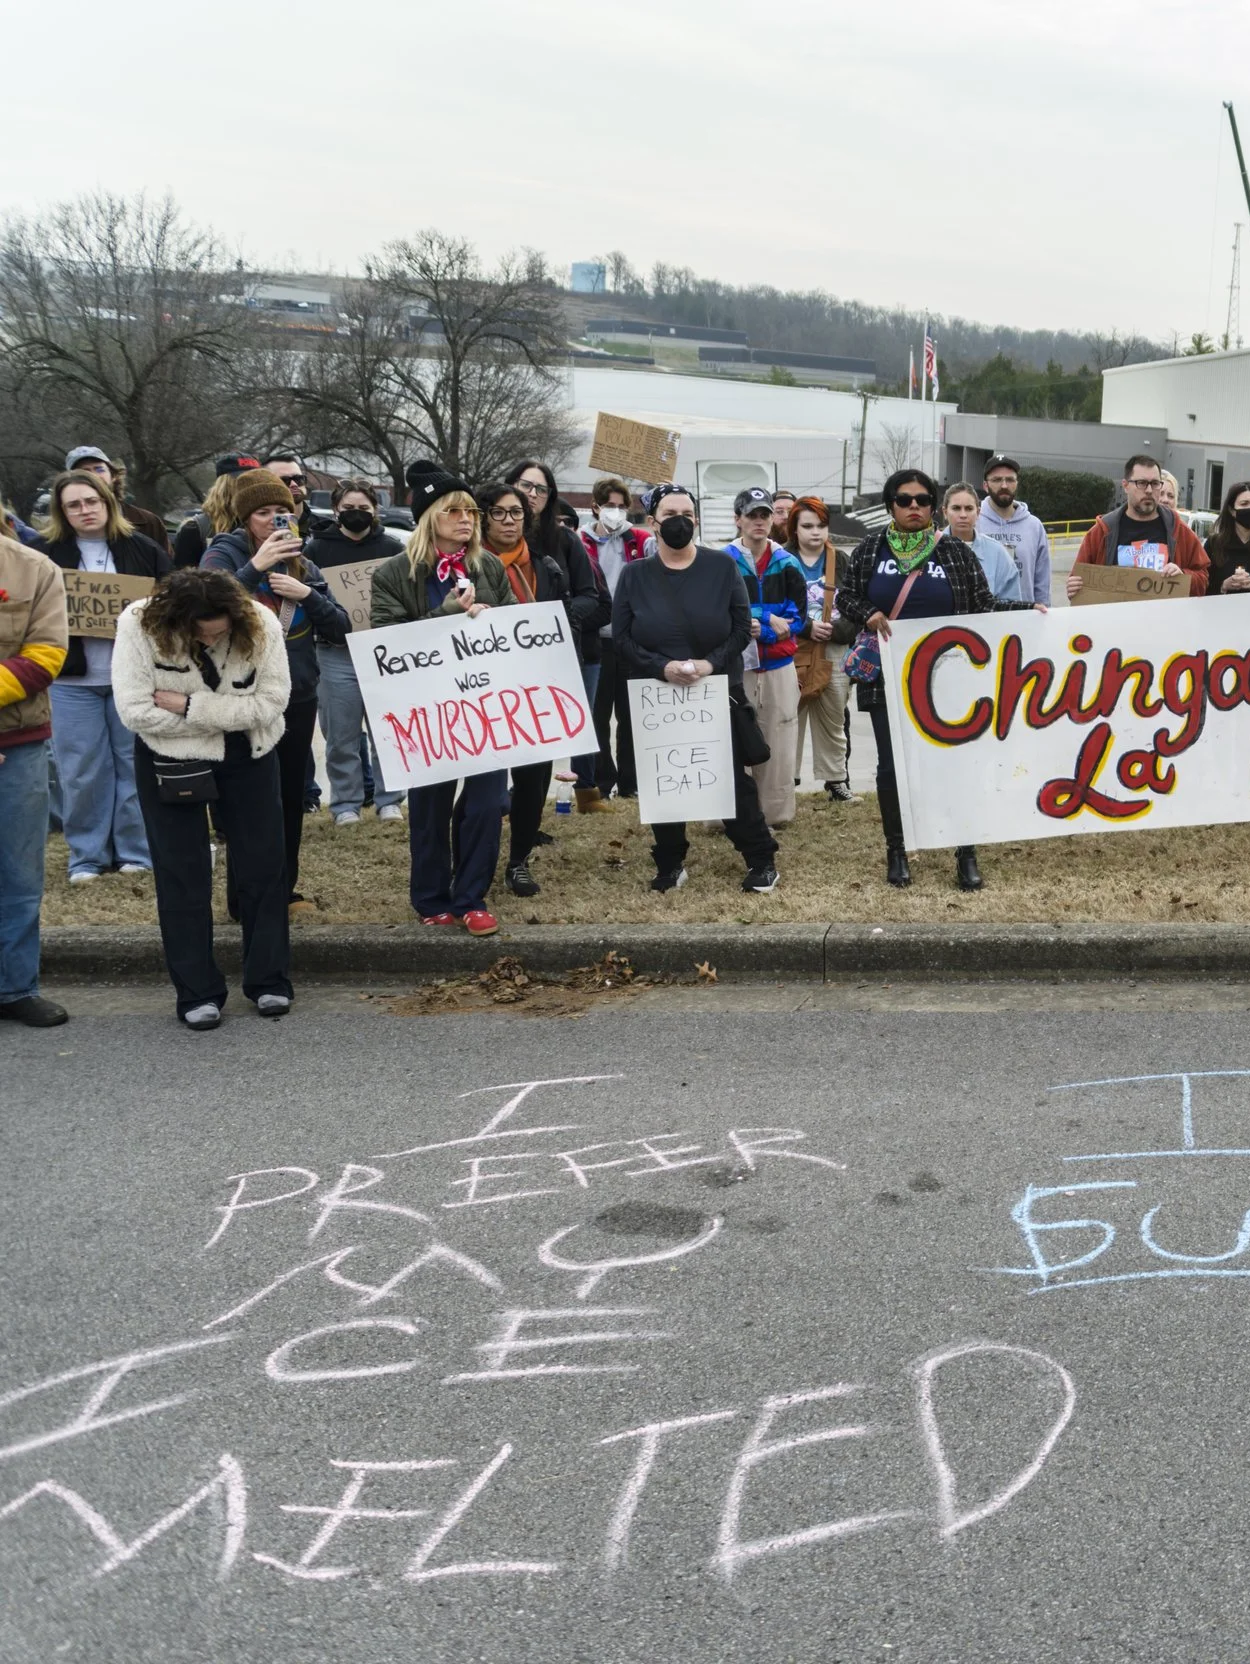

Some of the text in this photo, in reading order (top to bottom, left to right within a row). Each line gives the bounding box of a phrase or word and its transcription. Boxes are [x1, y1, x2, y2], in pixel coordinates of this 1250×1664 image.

[600, 413, 645, 437] REST IN
[605, 429, 643, 451] POWER
[339, 565, 378, 590] RES
[877, 559, 900, 576] IC
[89, 582, 121, 596] WAS
[1137, 576, 1180, 595] OUT
[68, 615, 84, 629] OT
[373, 615, 566, 677] Renee Nicole Good
[454, 671, 491, 693] was
[640, 682, 717, 709] RENEE
[382, 683, 586, 773] MURDERED
[642, 709, 714, 731] GOOD
[655, 747, 709, 773] ICE
[1036, 721, 1176, 821] La
[656, 767, 717, 797] BAD
[372, 1073, 625, 1159] I
[202, 1126, 849, 1249] PREFER
[0, 1309, 680, 1458] ICE
[0, 1344, 1077, 1584] MELTED
